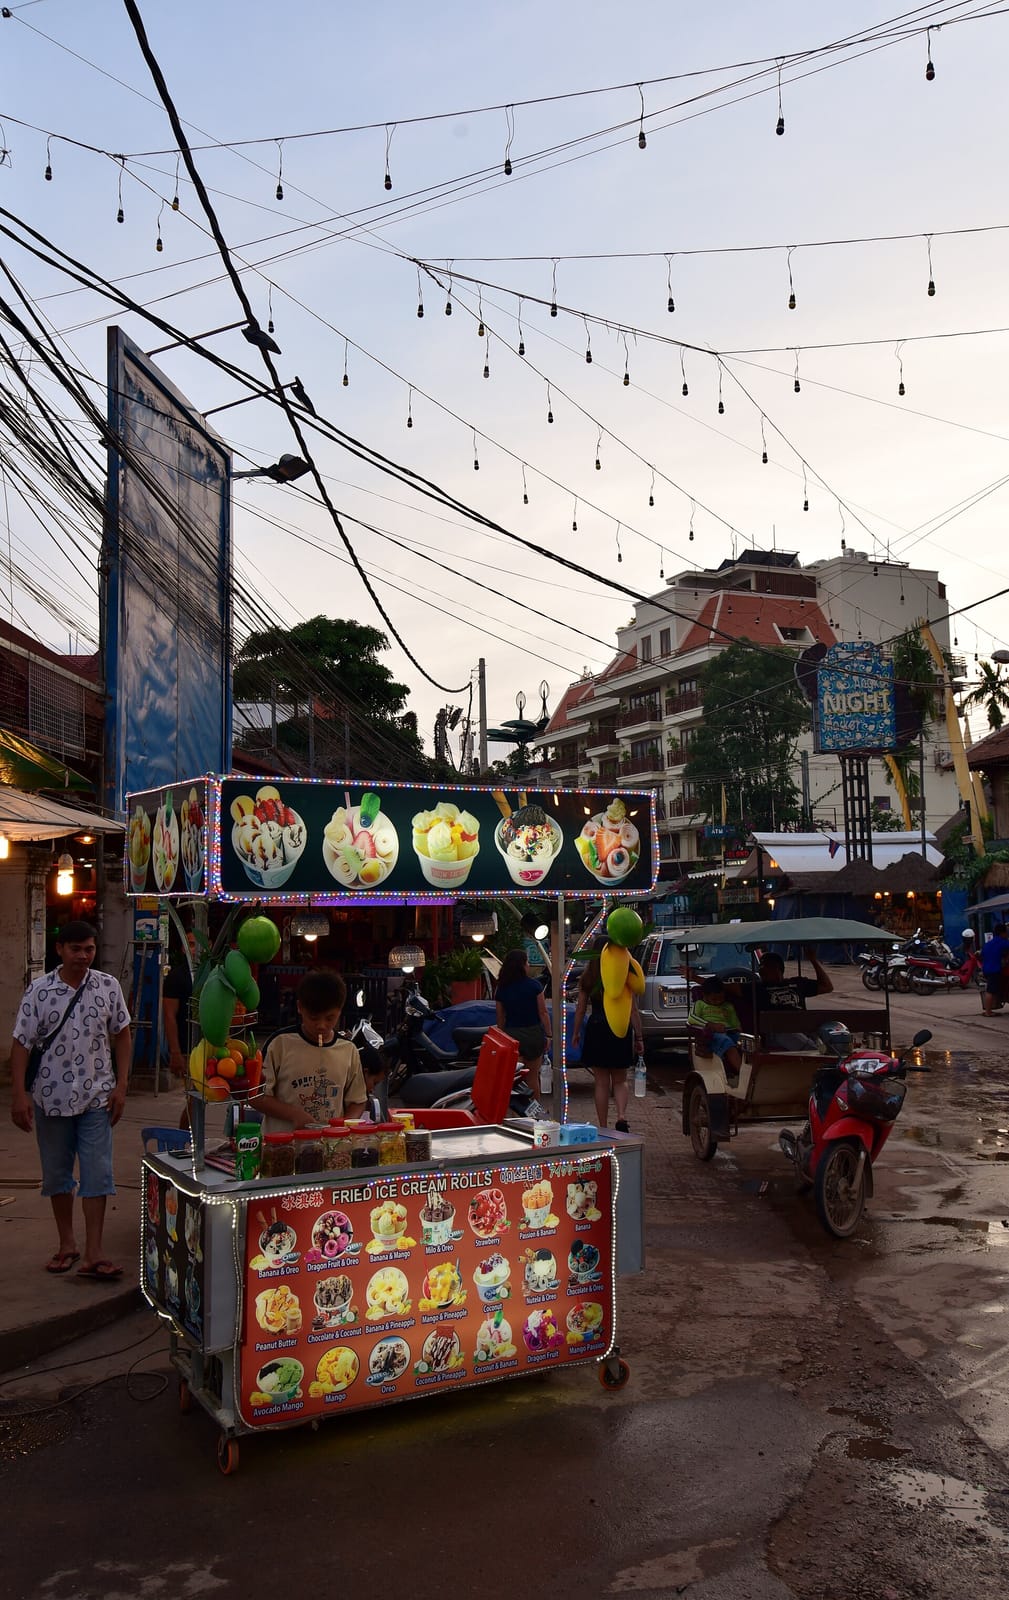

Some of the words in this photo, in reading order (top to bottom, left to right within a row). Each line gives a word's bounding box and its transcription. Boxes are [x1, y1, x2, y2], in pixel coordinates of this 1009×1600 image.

[823, 690, 890, 714] NIGHT
[239, 1141, 258, 1149] MILO
[332, 1186, 372, 1204] FRIED
[376, 1184, 397, 1199] ICE
[401, 1178, 447, 1196] CREAM
[451, 1173, 492, 1189] ROLLS
[575, 1223, 591, 1232] Banana
[520, 1232, 536, 1240] Passion
[541, 1229, 557, 1237] Banana
[437, 1245, 441, 1253] &
[442, 1244, 454, 1252] Oreo
[475, 1237, 500, 1248] Strawberry
[370, 1254, 389, 1263] Banana
[394, 1251, 411, 1260] Mango
[307, 1262, 327, 1273] Dragon
[328, 1260, 341, 1269] Fruit
[341, 1259, 346, 1267] &
[346, 1258, 359, 1266] Oreo
[258, 1267, 280, 1279] Banana
[281, 1268, 286, 1276] &
[286, 1266, 300, 1275] Oreo
[567, 1287, 589, 1296] Chocolate
[593, 1284, 604, 1292] Oreo
[546, 1293, 557, 1301] Oreo
[484, 1304, 503, 1313] Coconut
[422, 1314, 439, 1324] Mango
[444, 1309, 467, 1320] Pineapple
[365, 1325, 385, 1334] Banana
[385, 1323, 390, 1331] &
[390, 1319, 415, 1330] Pineapple
[308, 1333, 335, 1343] Chocolate
[340, 1328, 362, 1338] Coconut
[256, 1342, 277, 1352] Peanut
[278, 1339, 297, 1349] Butter
[570, 1346, 586, 1355] Mango
[587, 1342, 605, 1351] Passion
[527, 1354, 546, 1364] Dragon
[546, 1352, 559, 1360] Fruit
[474, 1364, 495, 1374] Coconut
[500, 1360, 518, 1369] Banana
[415, 1375, 437, 1386] Coconut
[442, 1371, 466, 1382] Pineapple
[382, 1385, 396, 1394] Oreo
[325, 1394, 347, 1403] Mango
[253, 1406, 281, 1417] Avocado
[282, 1402, 304, 1413] Mango
